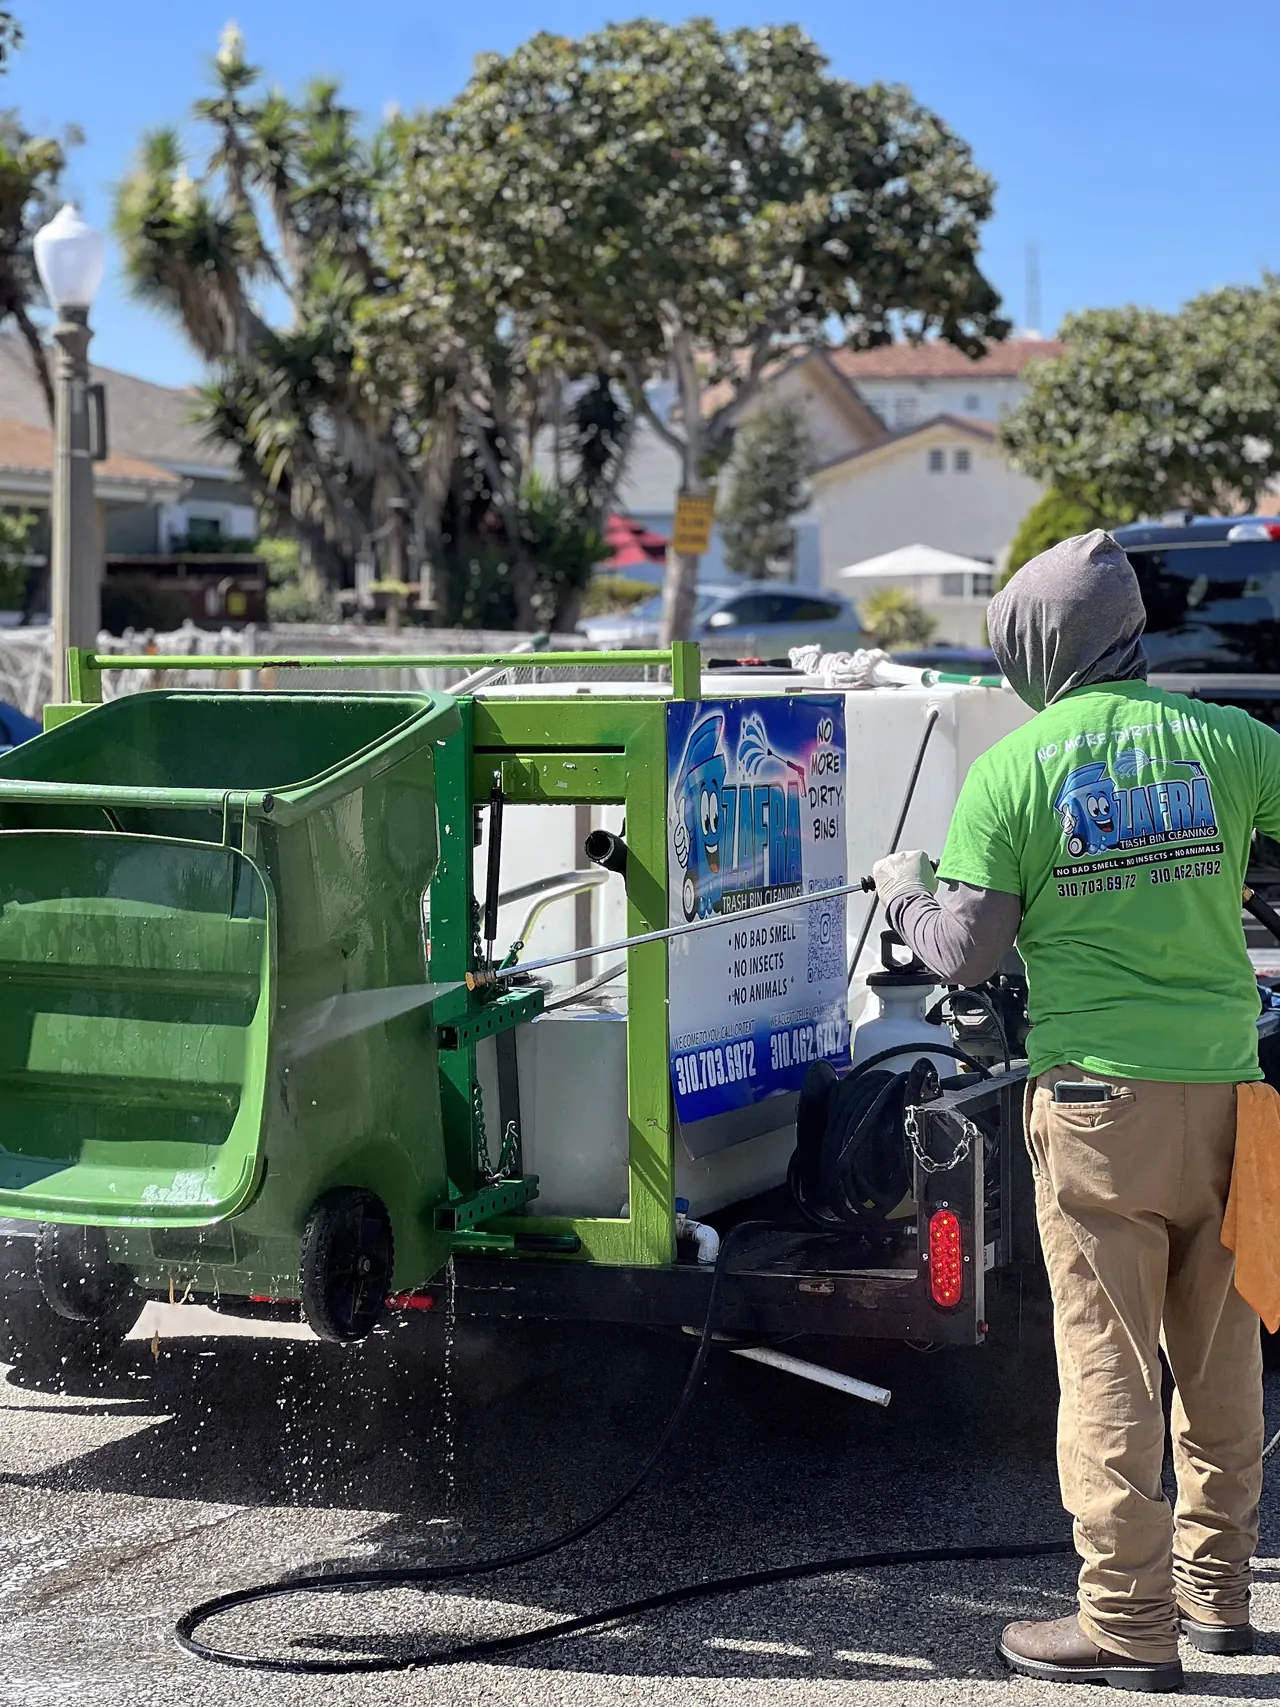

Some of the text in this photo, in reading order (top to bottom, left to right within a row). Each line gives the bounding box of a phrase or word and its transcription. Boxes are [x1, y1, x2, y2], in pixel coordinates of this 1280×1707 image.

[818, 719, 832, 743] NO
[1037, 743, 1058, 762] NO
[1064, 731, 1107, 752] MORE
[1111, 722, 1164, 743] DIRTY
[811, 752, 840, 776] MORE
[808, 785, 842, 810] DIRTY
[1112, 777, 1215, 839] ZAFRA
[722, 781, 802, 892] ZAFRA
[813, 814, 839, 842] BINS!
[1149, 832, 1165, 844] BIN
[1168, 826, 1215, 841] CLEANING
[1056, 844, 1220, 876] NO BAD SMELL NO INSECTS NO ANIMALS
[1057, 860, 1221, 897] 310.703.69.72 310.462.6792
[722, 885, 801, 914] TRASH BIN CLEANING
[734, 923, 796, 950] NO BAD SMELL
[734, 951, 784, 978] NO INSECTS
[734, 977, 788, 1006] NO ANIMALS
[673, 1036, 682, 1051] WE
[683, 1032, 699, 1048] COME
[700, 1030, 707, 1044] TO
[721, 1024, 734, 1039] CALL
[743, 1019, 756, 1034] TEXT
[770, 1019, 844, 1071] 310.462.6792
[675, 1040, 757, 1096] 310.703.6972
